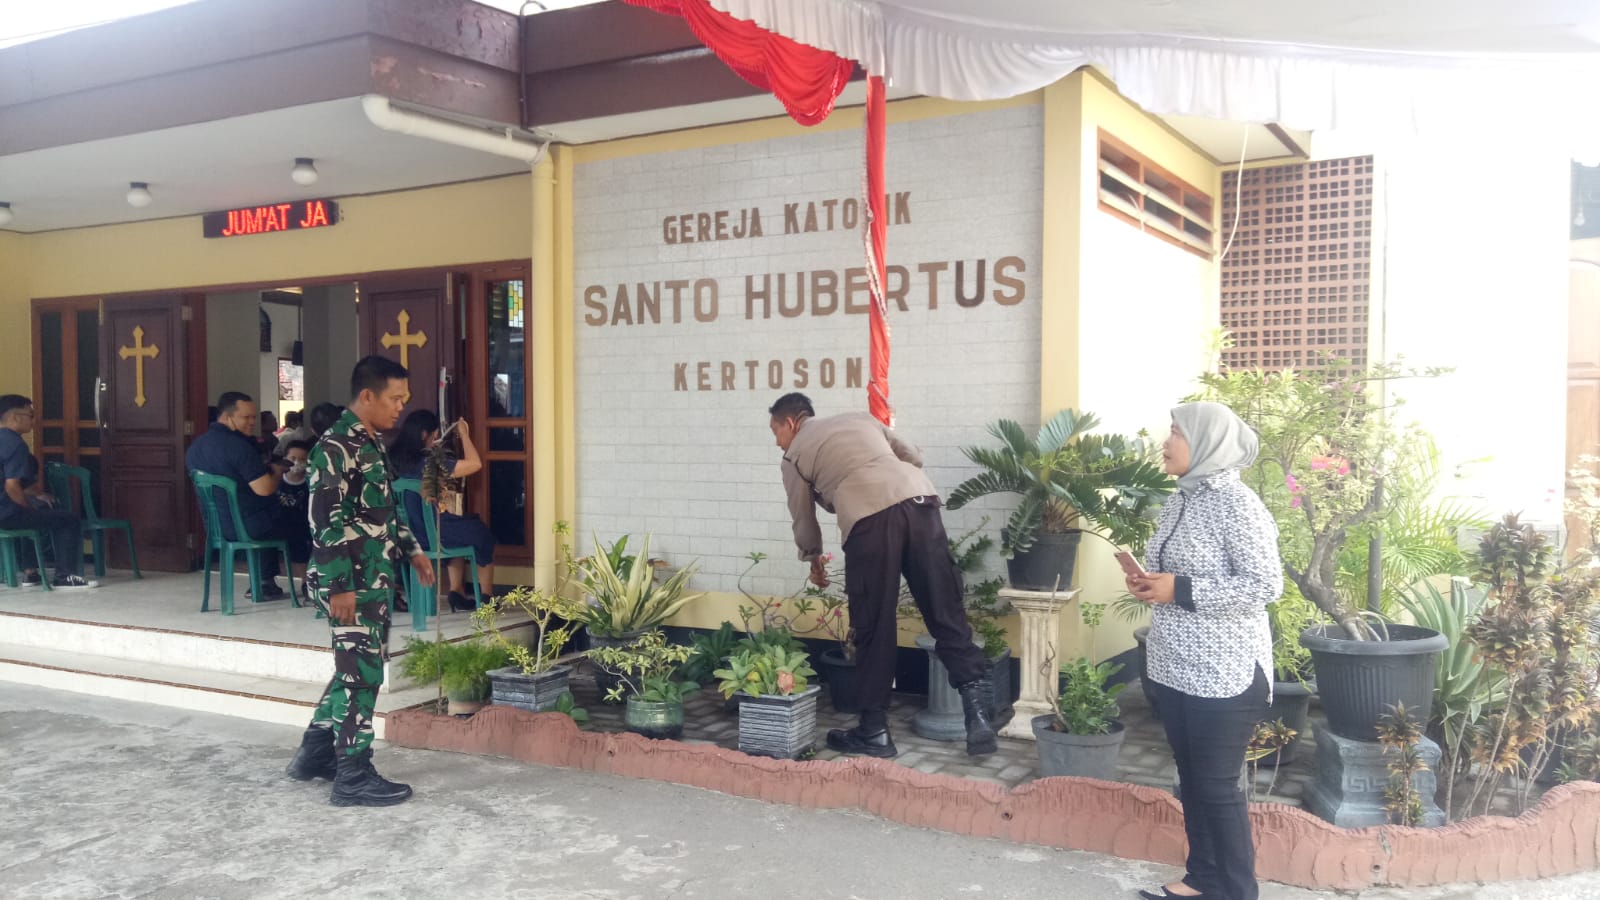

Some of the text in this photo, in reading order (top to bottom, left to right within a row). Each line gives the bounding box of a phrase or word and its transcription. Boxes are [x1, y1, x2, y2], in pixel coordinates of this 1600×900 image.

[222, 200, 328, 236] JUM'AT JA
[662, 191, 912, 245] GEREJA KATOIK
[584, 255, 1027, 327] SANTO HUBERTUS
[673, 357, 863, 391] KERTOSON
